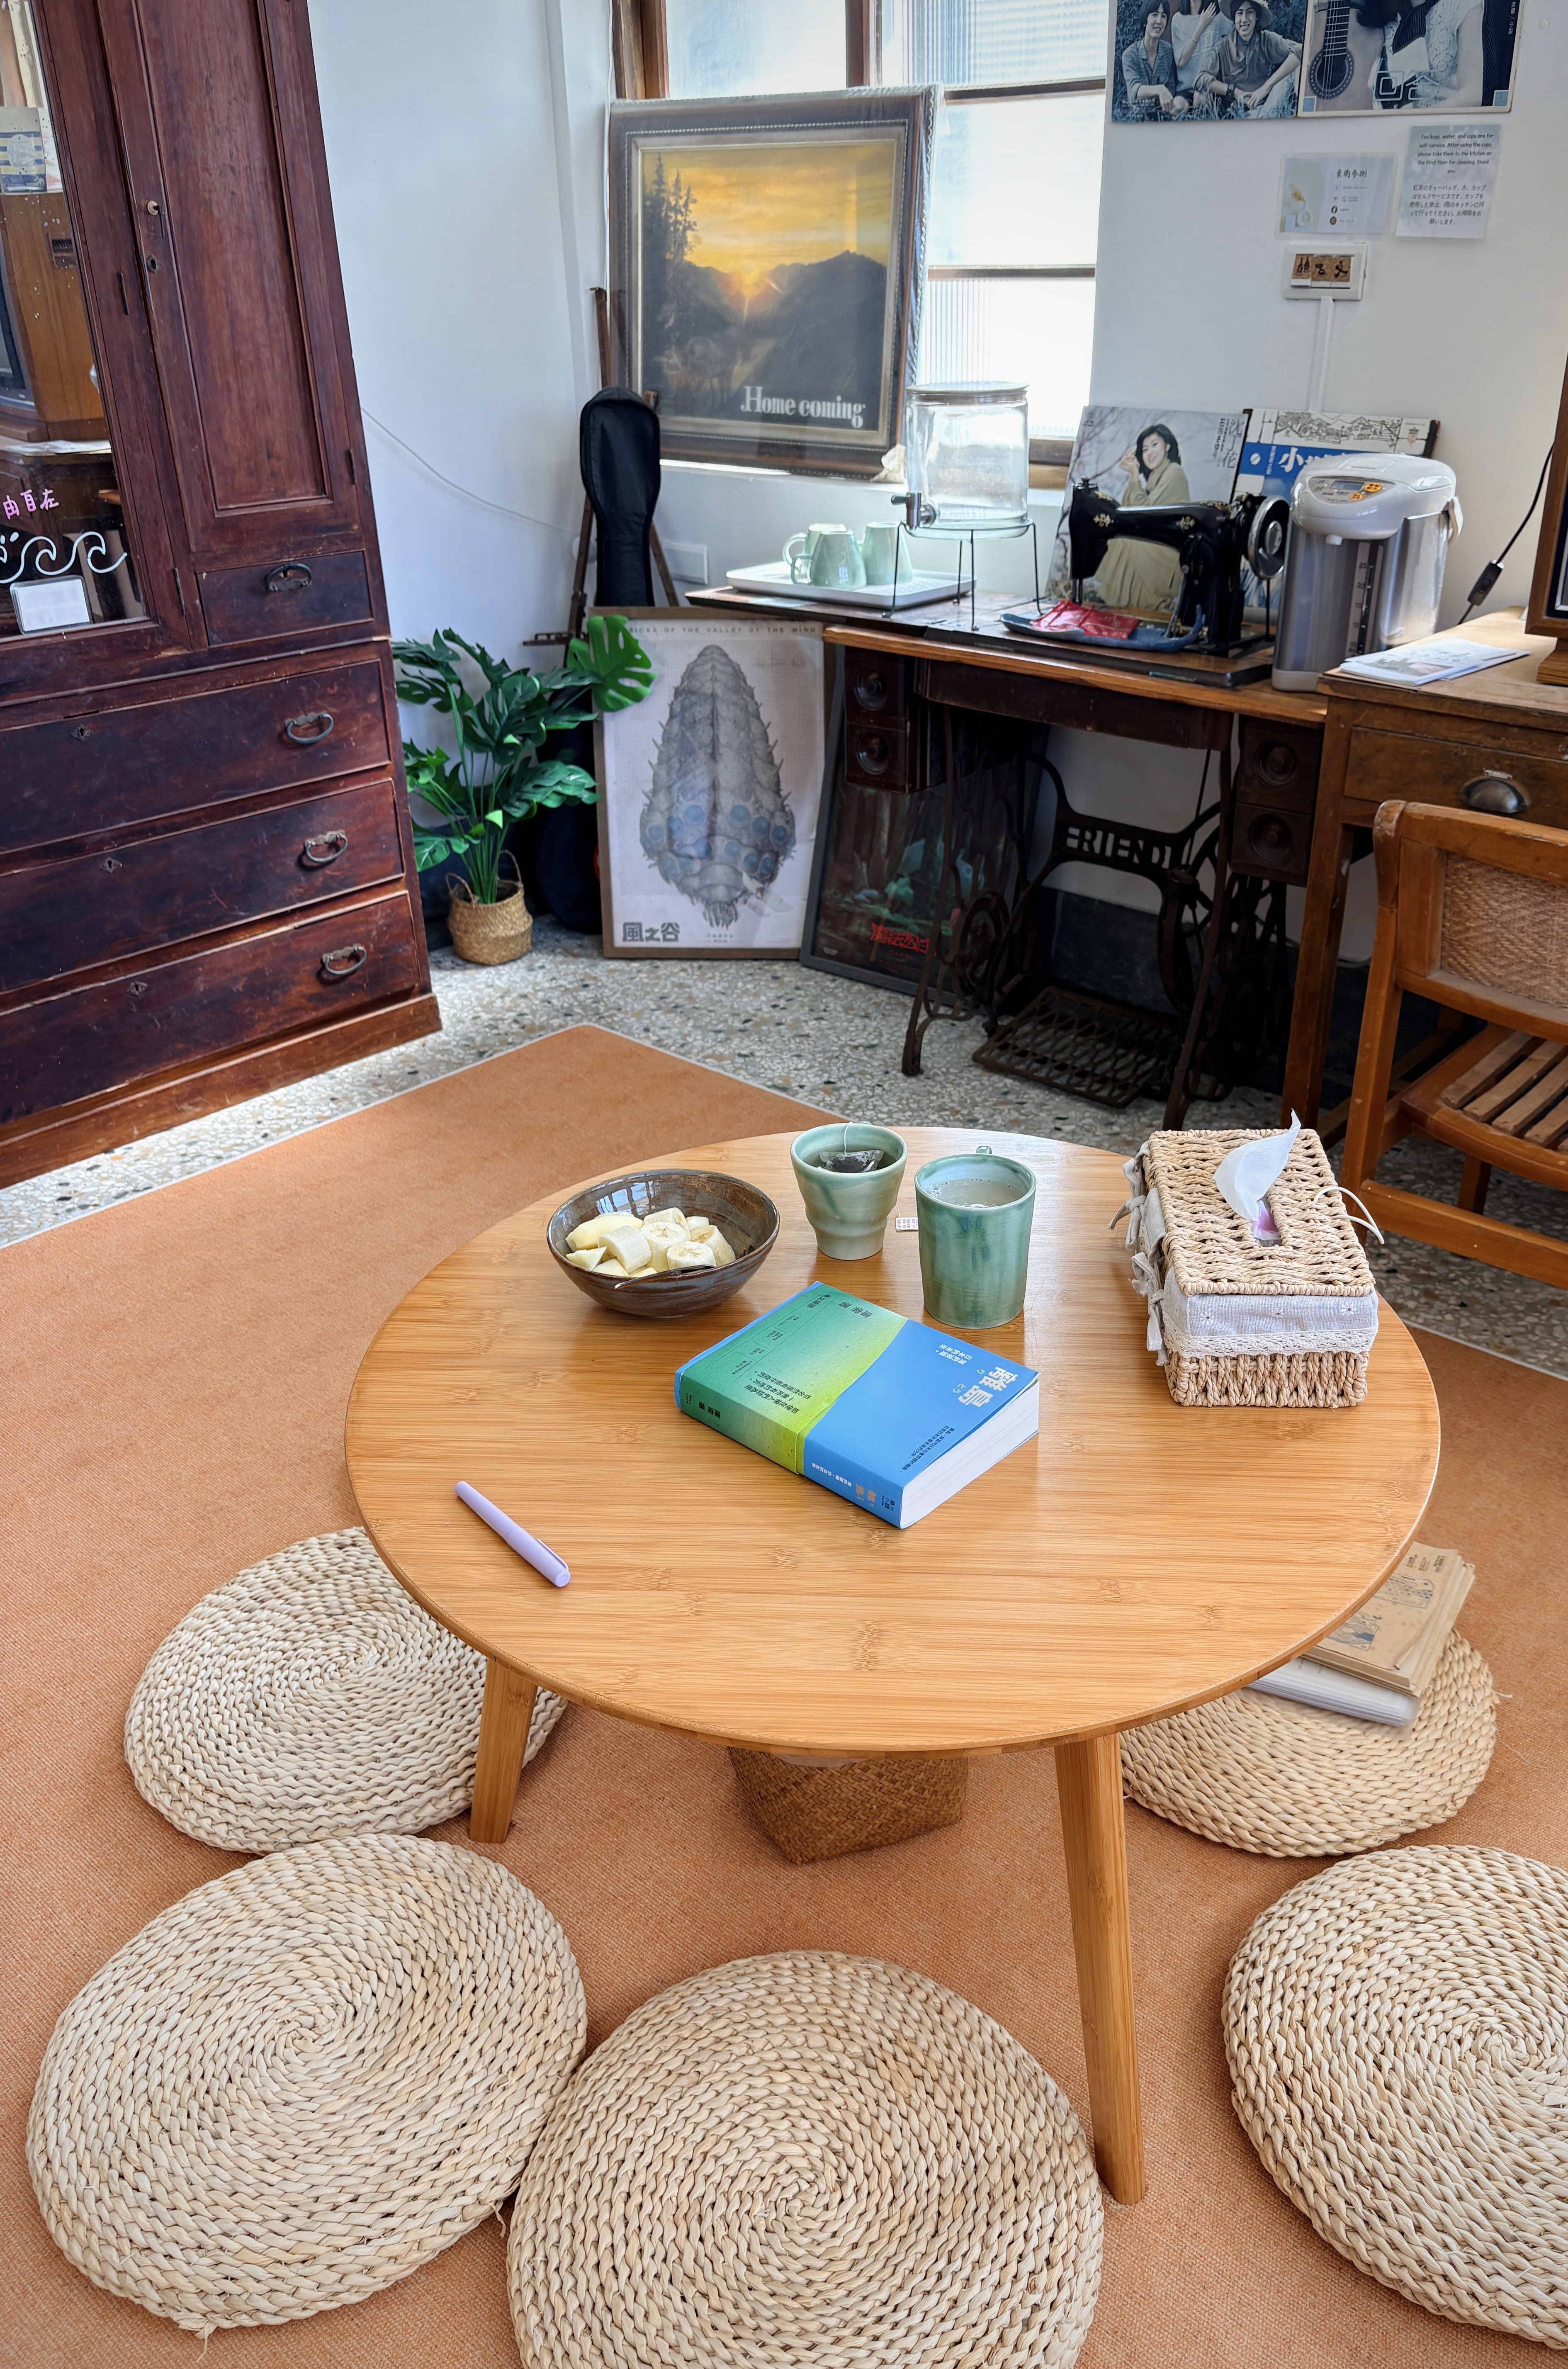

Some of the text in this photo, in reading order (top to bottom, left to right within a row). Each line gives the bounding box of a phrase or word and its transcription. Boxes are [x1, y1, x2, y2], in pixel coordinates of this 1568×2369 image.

[740, 385, 866, 428] Home coming
[622, 922, 680, 942] 風之谷
[958, 1367, 1019, 1408] 離島
